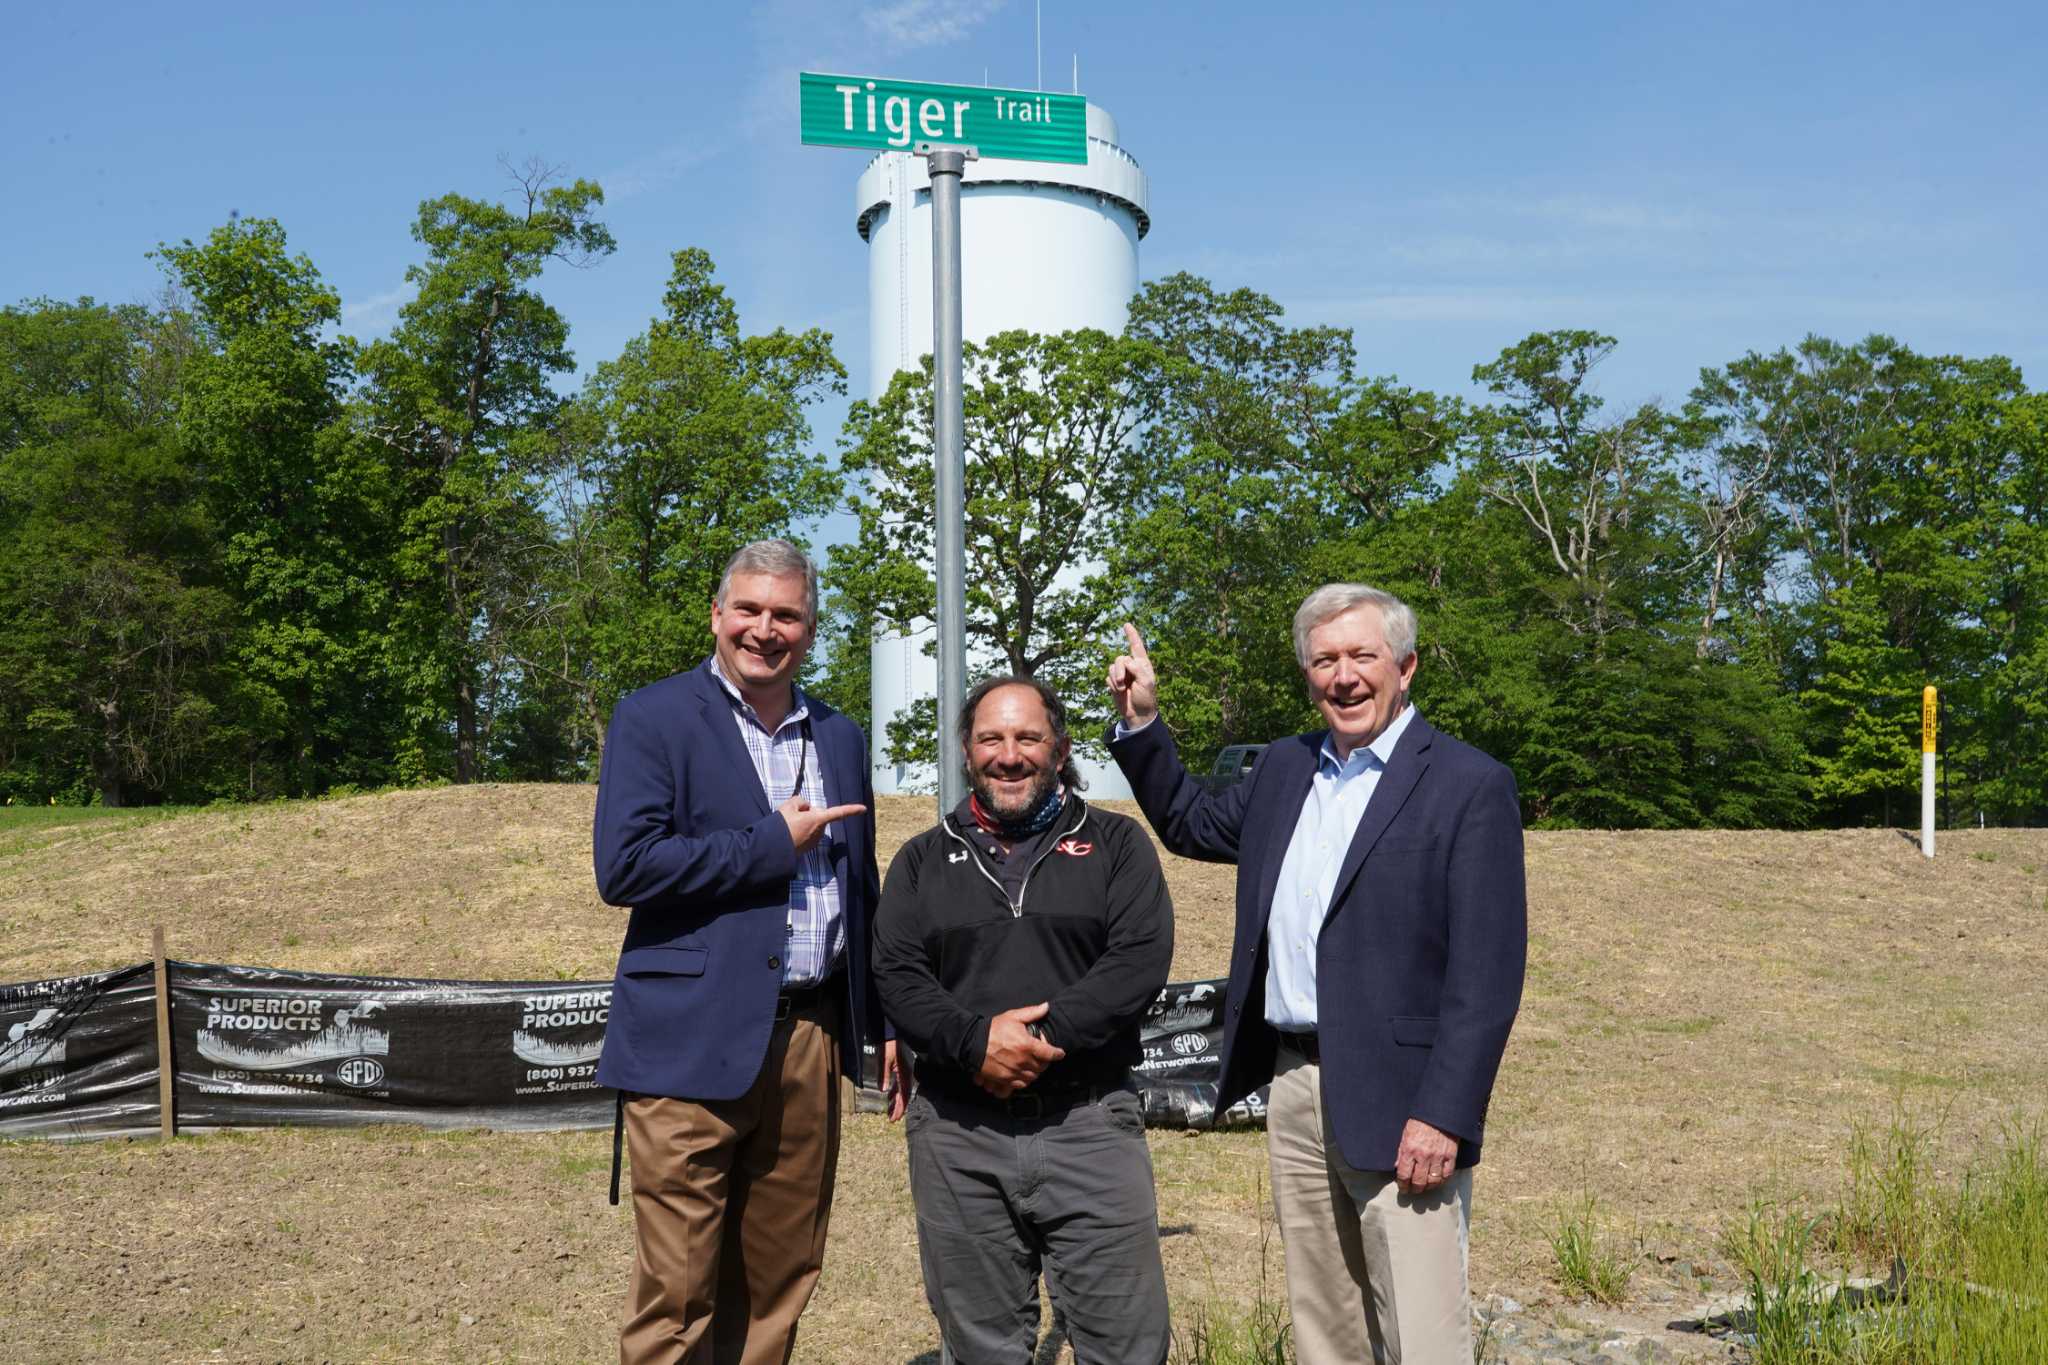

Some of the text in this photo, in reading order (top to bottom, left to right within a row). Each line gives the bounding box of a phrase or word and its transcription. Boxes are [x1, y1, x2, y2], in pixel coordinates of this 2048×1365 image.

[835, 82, 1052, 146] Tiger Trail
[208, 997, 323, 1015] SUPERIOR
[523, 991, 613, 1012] SUPERIO
[206, 1014, 322, 1031] PRODUCTS
[522, 1008, 610, 1029] PRODUC
[526, 1067, 564, 1082] (800)
